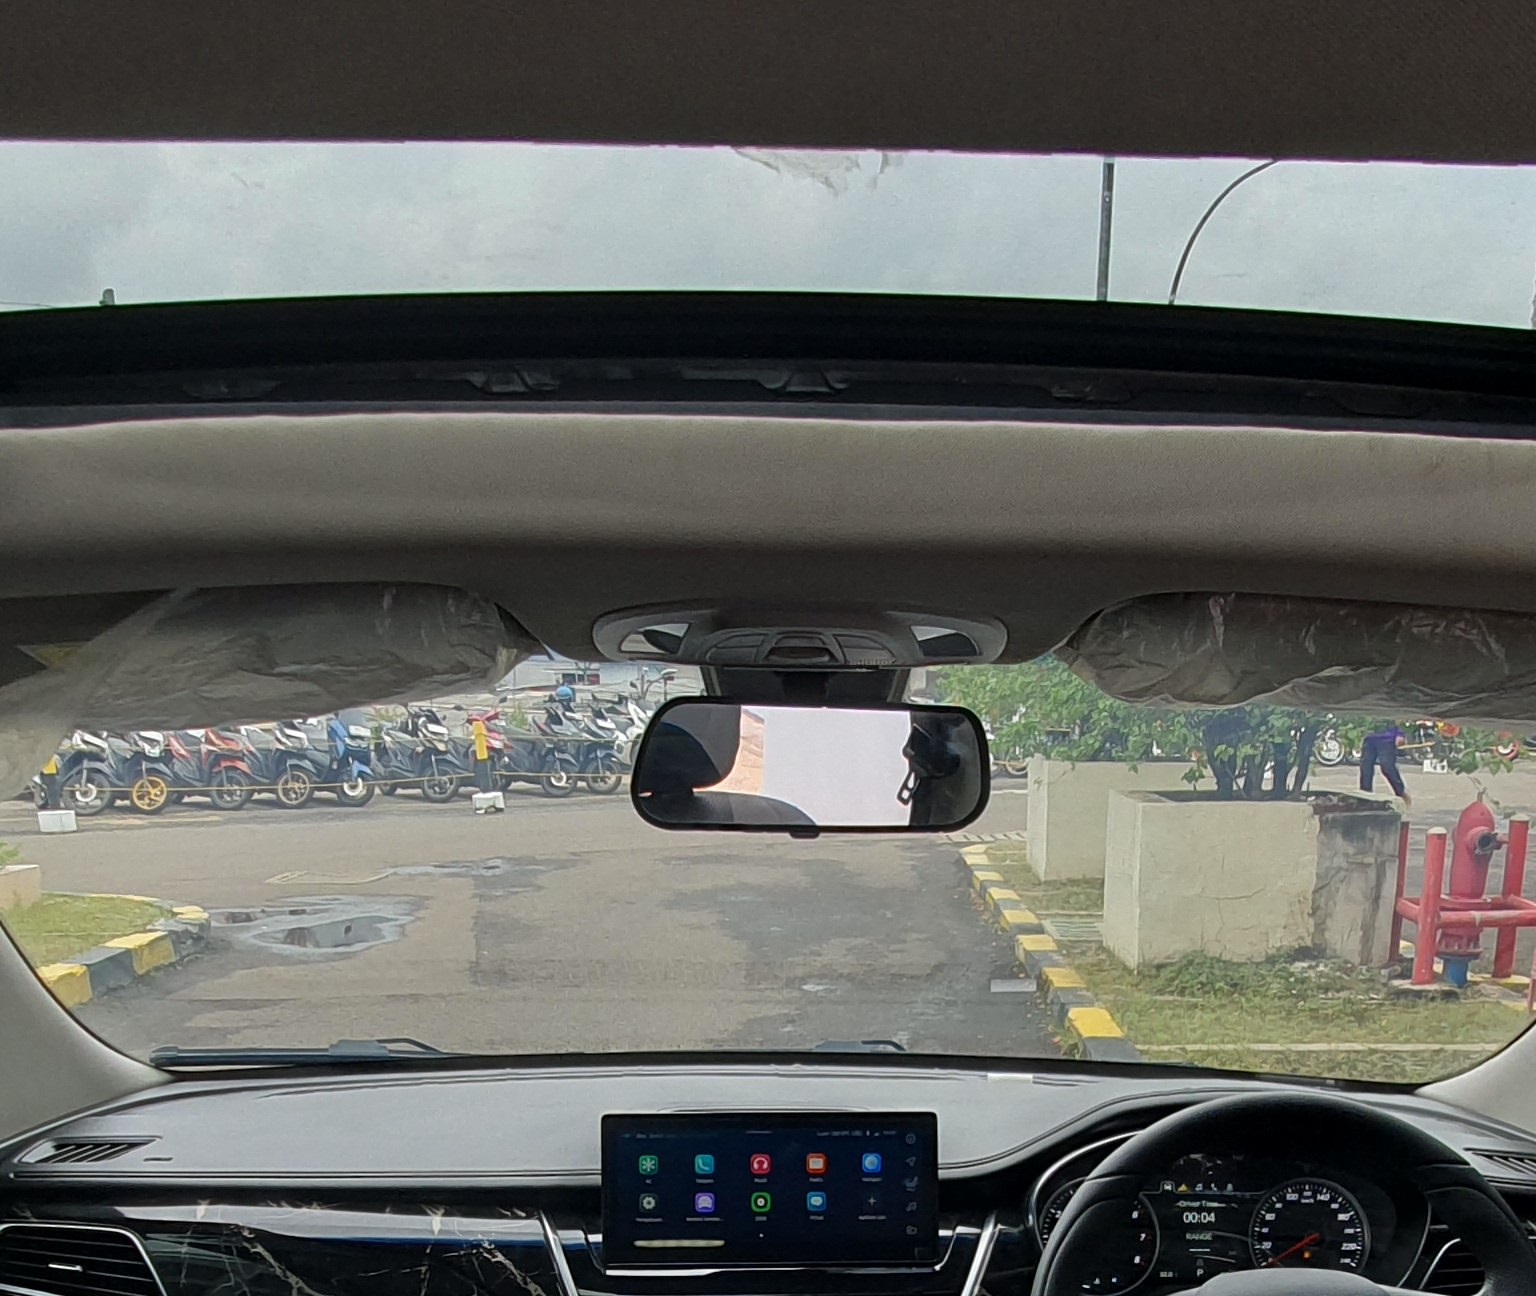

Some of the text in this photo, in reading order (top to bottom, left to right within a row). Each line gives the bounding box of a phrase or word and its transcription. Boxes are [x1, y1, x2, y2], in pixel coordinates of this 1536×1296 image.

[1182, 1211, 1216, 1223] 00:04
[1185, 1232, 1214, 1241] RANGE
[1196, 1268, 1205, 1277] P
